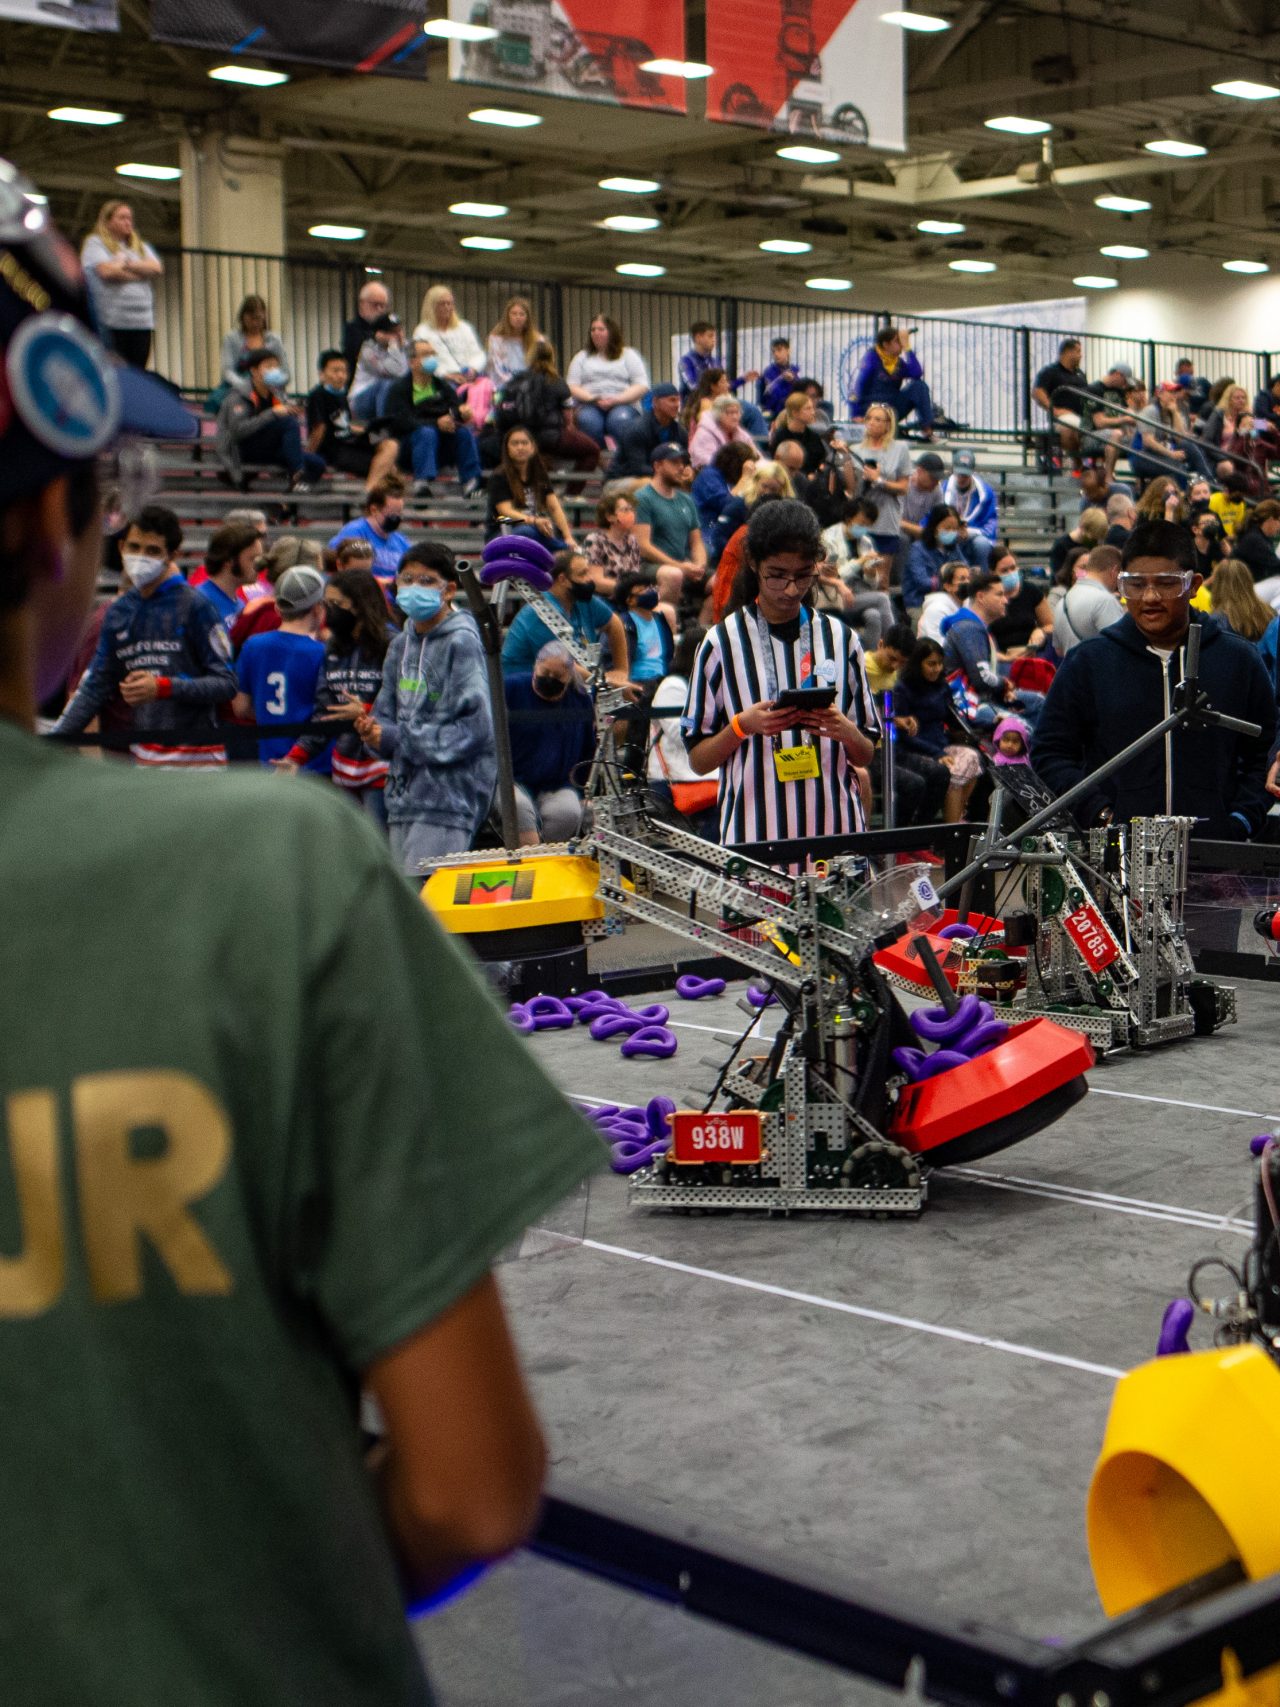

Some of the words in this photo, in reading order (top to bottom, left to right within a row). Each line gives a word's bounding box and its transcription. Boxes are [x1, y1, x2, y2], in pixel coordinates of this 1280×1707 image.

[266, 671, 287, 716] 3
[1071, 911, 1109, 958] 20785
[691, 1126, 744, 1150] 938W
